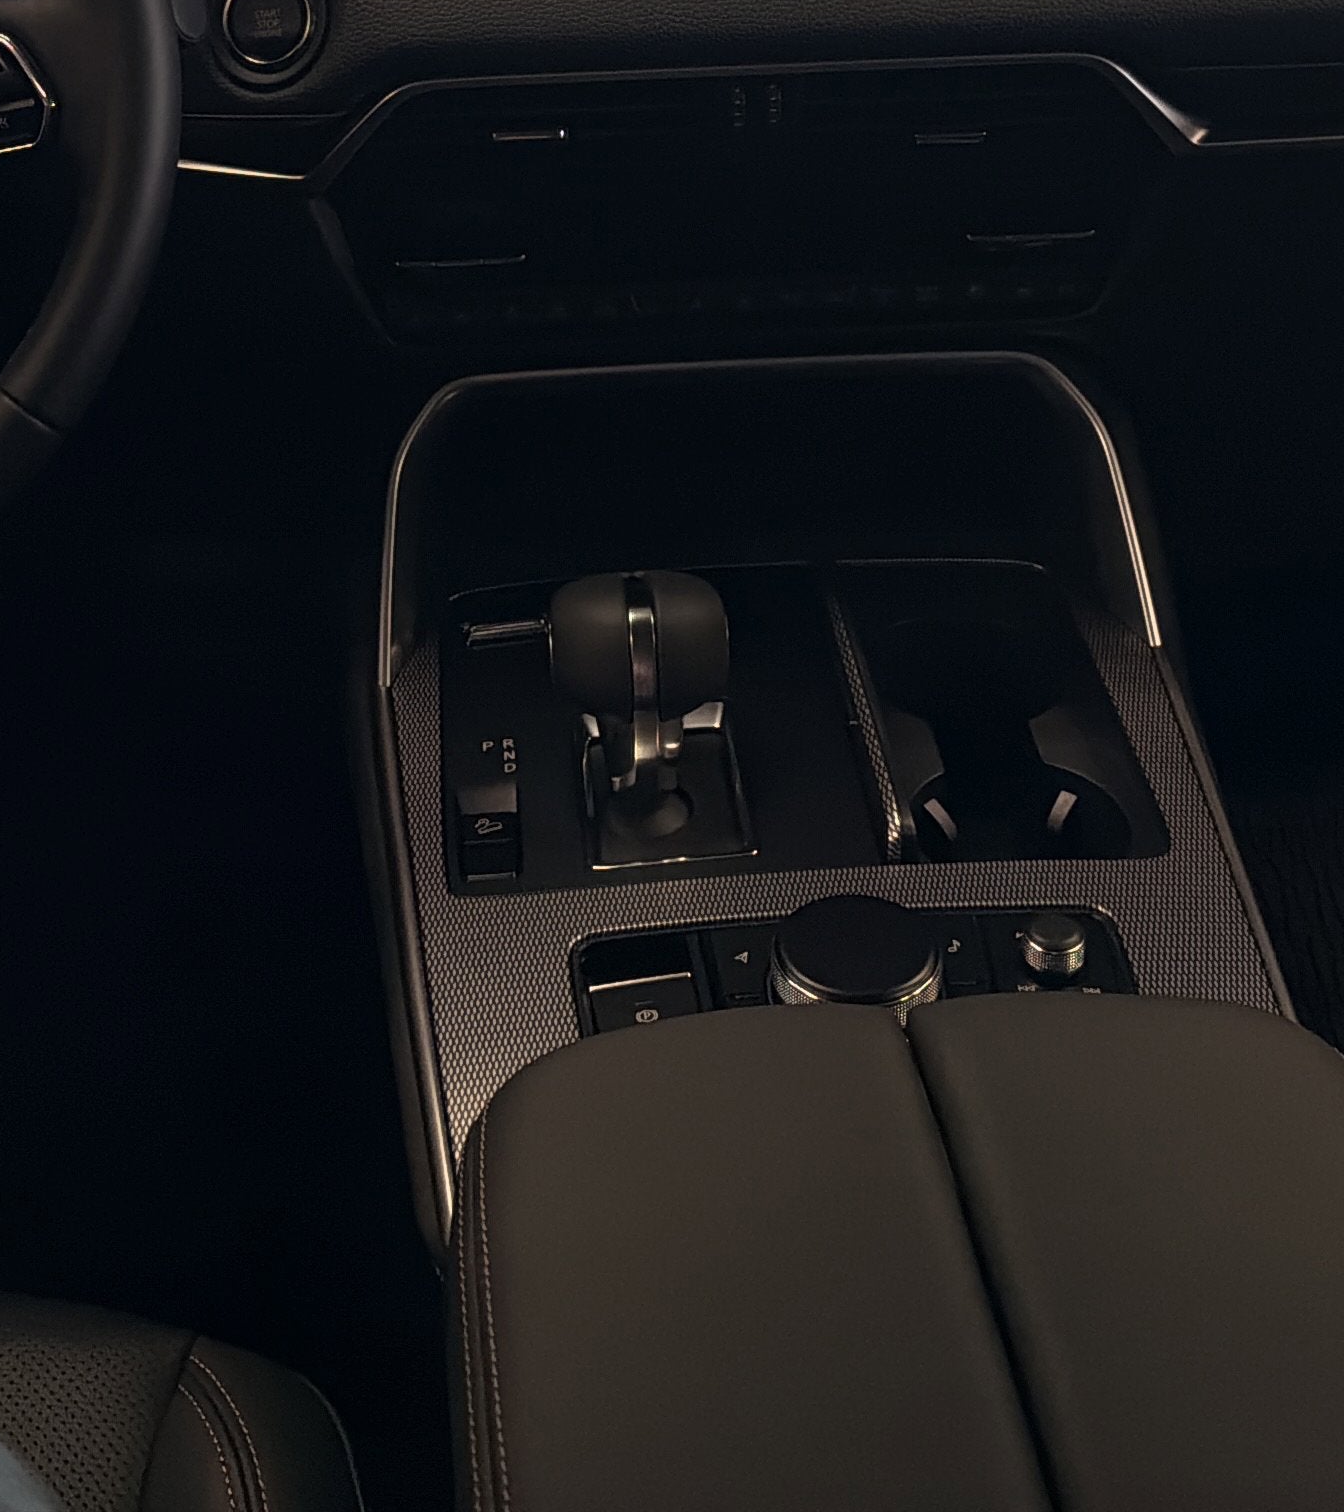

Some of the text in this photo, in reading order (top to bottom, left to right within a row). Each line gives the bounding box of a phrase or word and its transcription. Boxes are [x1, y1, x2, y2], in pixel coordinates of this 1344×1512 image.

[482, 740, 495, 753] P
[502, 738, 515, 749] R
[503, 749, 516, 761] N
[504, 762, 517, 773] D
